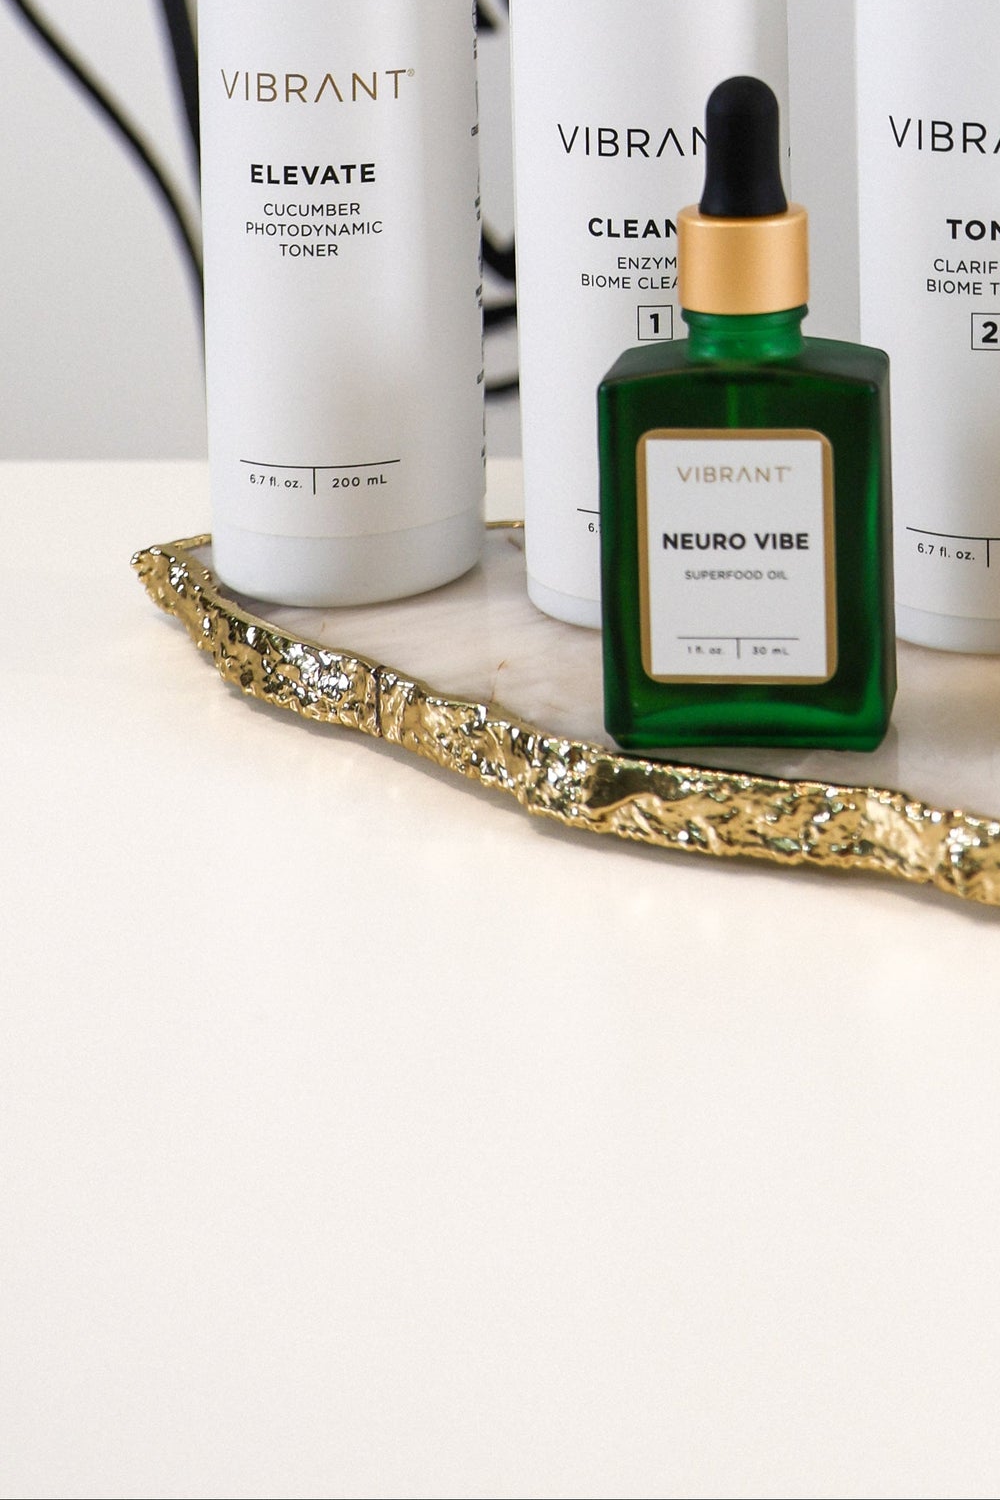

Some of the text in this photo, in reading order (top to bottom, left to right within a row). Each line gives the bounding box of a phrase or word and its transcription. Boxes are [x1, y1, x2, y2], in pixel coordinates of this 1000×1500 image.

[557, 123, 706, 157] VIBRAN
[250, 162, 376, 186] ELEVATE
[263, 202, 361, 217] CUCUMBER
[246, 220, 383, 237] PHOTODYNAMIC
[588, 217, 678, 238] CLEAN
[279, 243, 339, 257] TONER
[617, 256, 677, 270] ENZYM
[581, 273, 632, 290] BIOME
[926, 278, 983, 296] BIOME
[649, 312, 660, 334] 1
[981, 320, 999, 344] 2
[249, 473, 303, 489] 6.7 fl. oz.
[332, 473, 388, 489] 200 mL
[662, 532, 809, 551] NEURO VIBE
[917, 542, 976, 561] 6.7 fl. oz.
[684, 569, 788, 581] SUPERFOOD OIL
